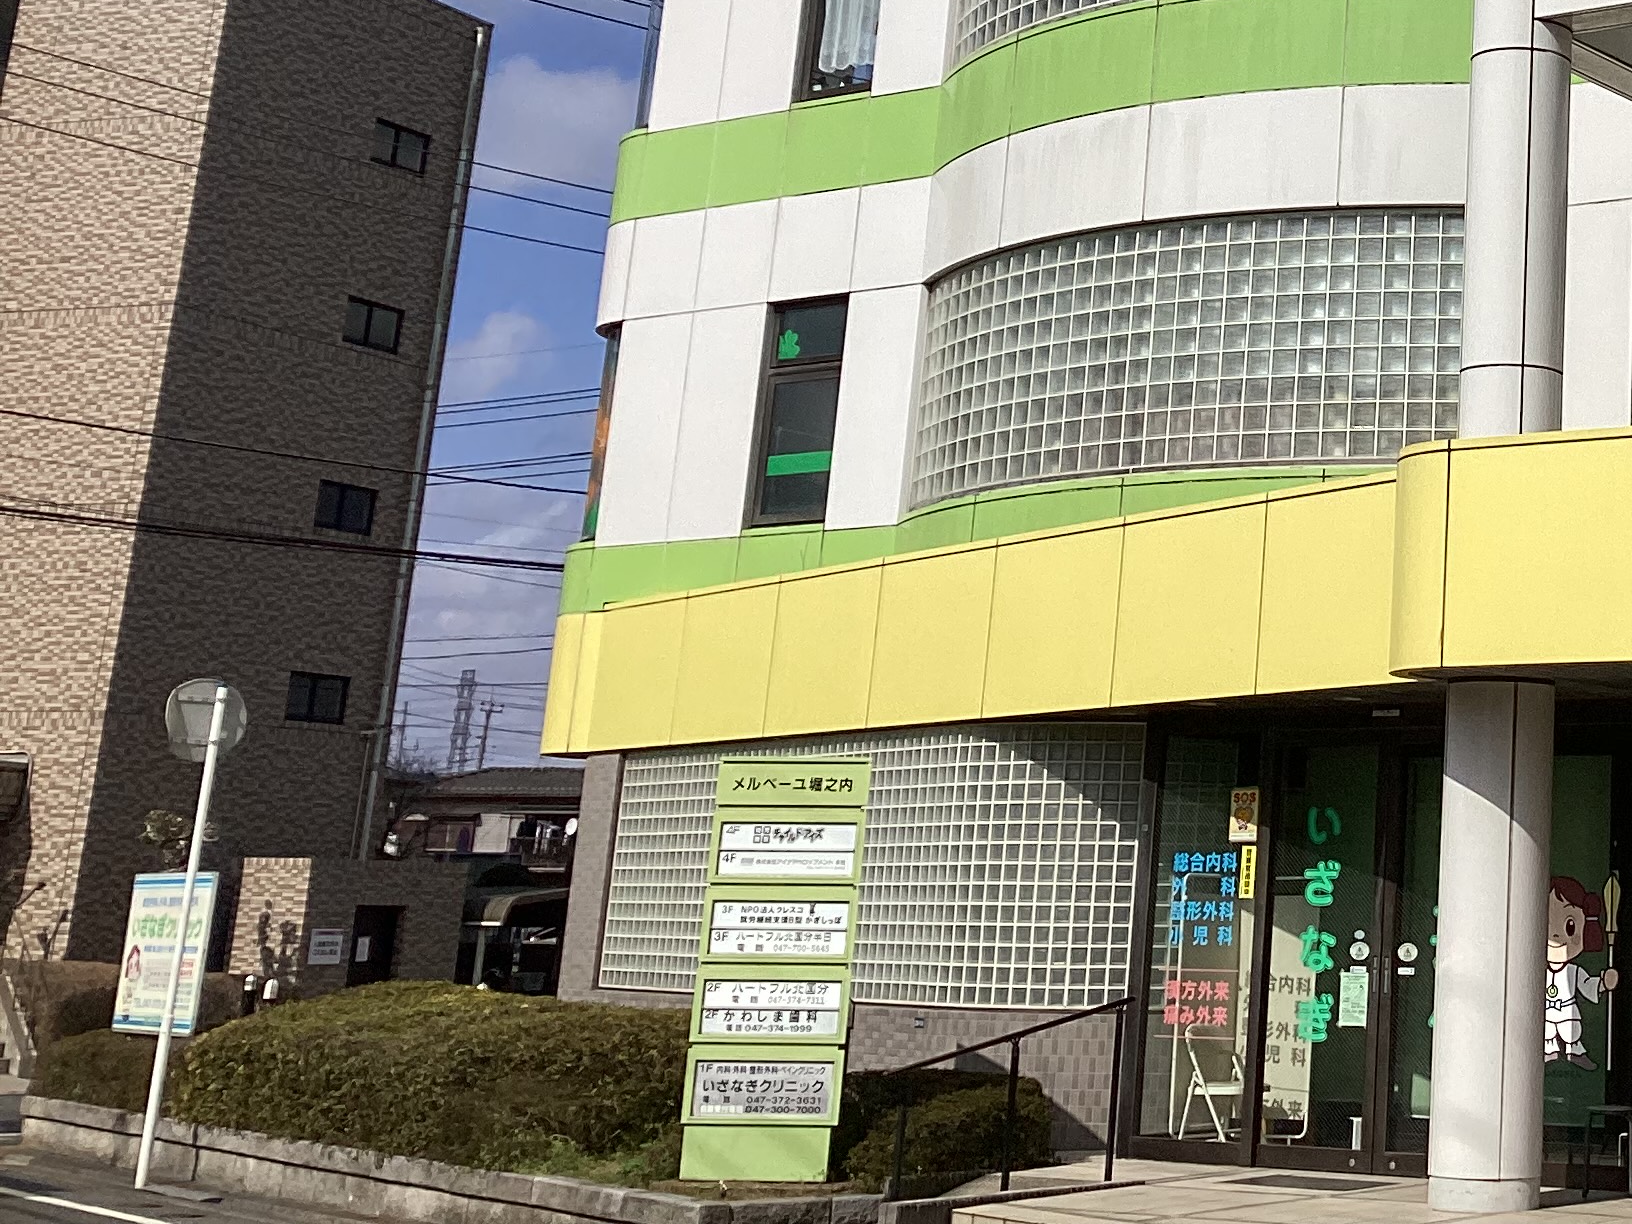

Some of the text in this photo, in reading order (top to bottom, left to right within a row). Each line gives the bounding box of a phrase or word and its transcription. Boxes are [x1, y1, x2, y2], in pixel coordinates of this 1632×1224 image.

[732, 777, 853, 792] メルベーユ堀之内
[1233, 792, 1257, 804] SOS
[726, 825, 741, 834] 4F
[722, 853, 737, 863] 4F
[1173, 852, 1238, 872] 総合内科
[722, 905, 734, 914] 3F
[714, 931, 729, 941] 3F
[707, 983, 722, 992] 2F
[704, 1010, 817, 1023] 2F かわしま歯科
[699, 1064, 713, 1073] 1F
[703, 1079, 824, 1093] いざなぎクリニック
[746, 1096, 821, 1104] 047-372-3631
